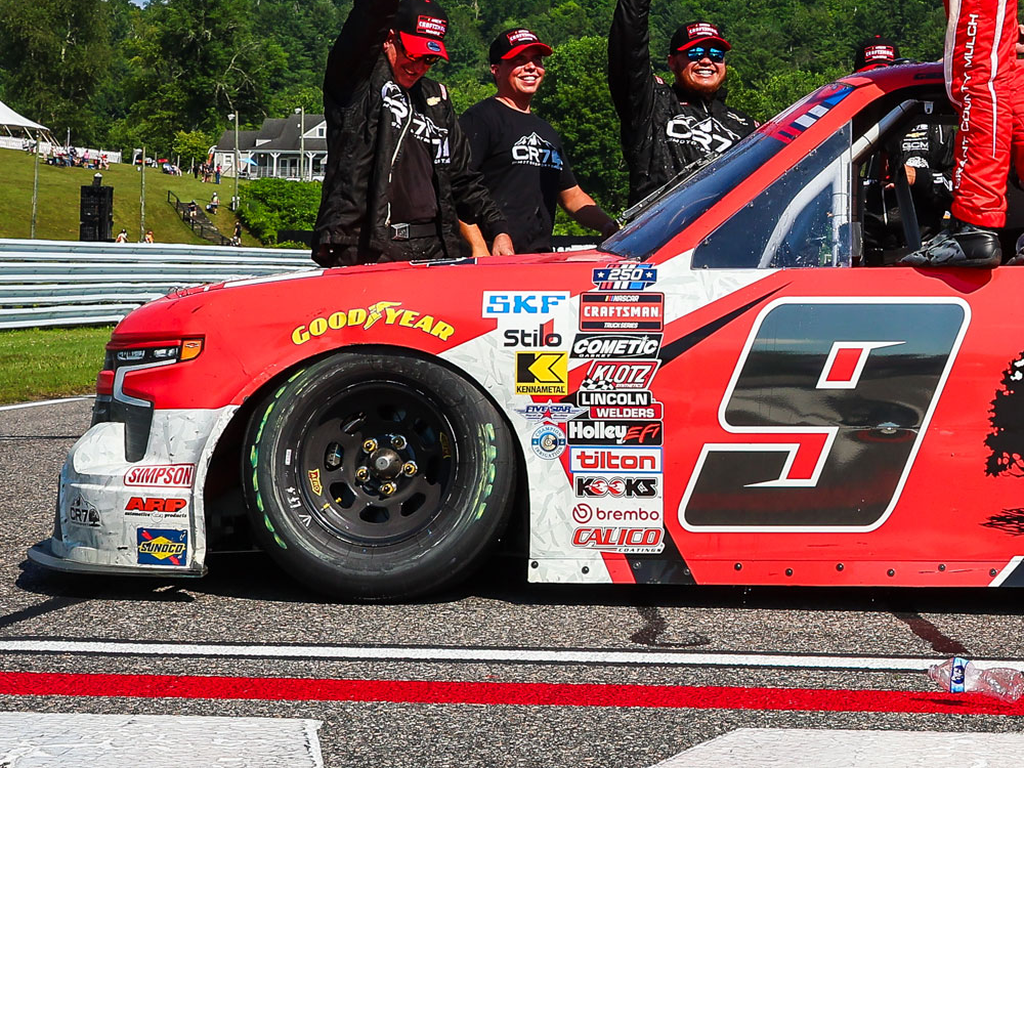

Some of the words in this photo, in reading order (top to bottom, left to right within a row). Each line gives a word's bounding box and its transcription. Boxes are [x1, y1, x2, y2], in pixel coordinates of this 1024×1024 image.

[964, 14, 980, 67] MULCH
[512, 145, 550, 163] CR7
[608, 269, 644, 281] 250
[486, 295, 566, 314] SKF
[584, 306, 659, 317] CRAFTSMAN
[291, 302, 455, 345] GOODYEAR
[504, 322, 562, 347] Stilo
[573, 337, 659, 355] COMETIC
[592, 365, 652, 383] KLOTZ
[516, 385, 566, 394] KENNAMETAL
[581, 393, 648, 406] LINCOLN
[525, 405, 548, 413] FIVE
[549, 405, 573, 413] STAR
[596, 408, 655, 418] WELDERS
[677, 296, 972, 533] 9
[535, 426, 563, 438] CHAMPION
[569, 421, 629, 444] Holley
[534, 446, 563, 458] IRRIGATION
[576, 451, 656, 469] tilton
[128, 467, 193, 485] SIMPSON
[577, 478, 657, 497] KOOKS
[125, 497, 187, 512] ARP
[596, 508, 660, 521] brembo
[573, 527, 663, 547] CALICO
[141, 542, 183, 554] SUNOCO
